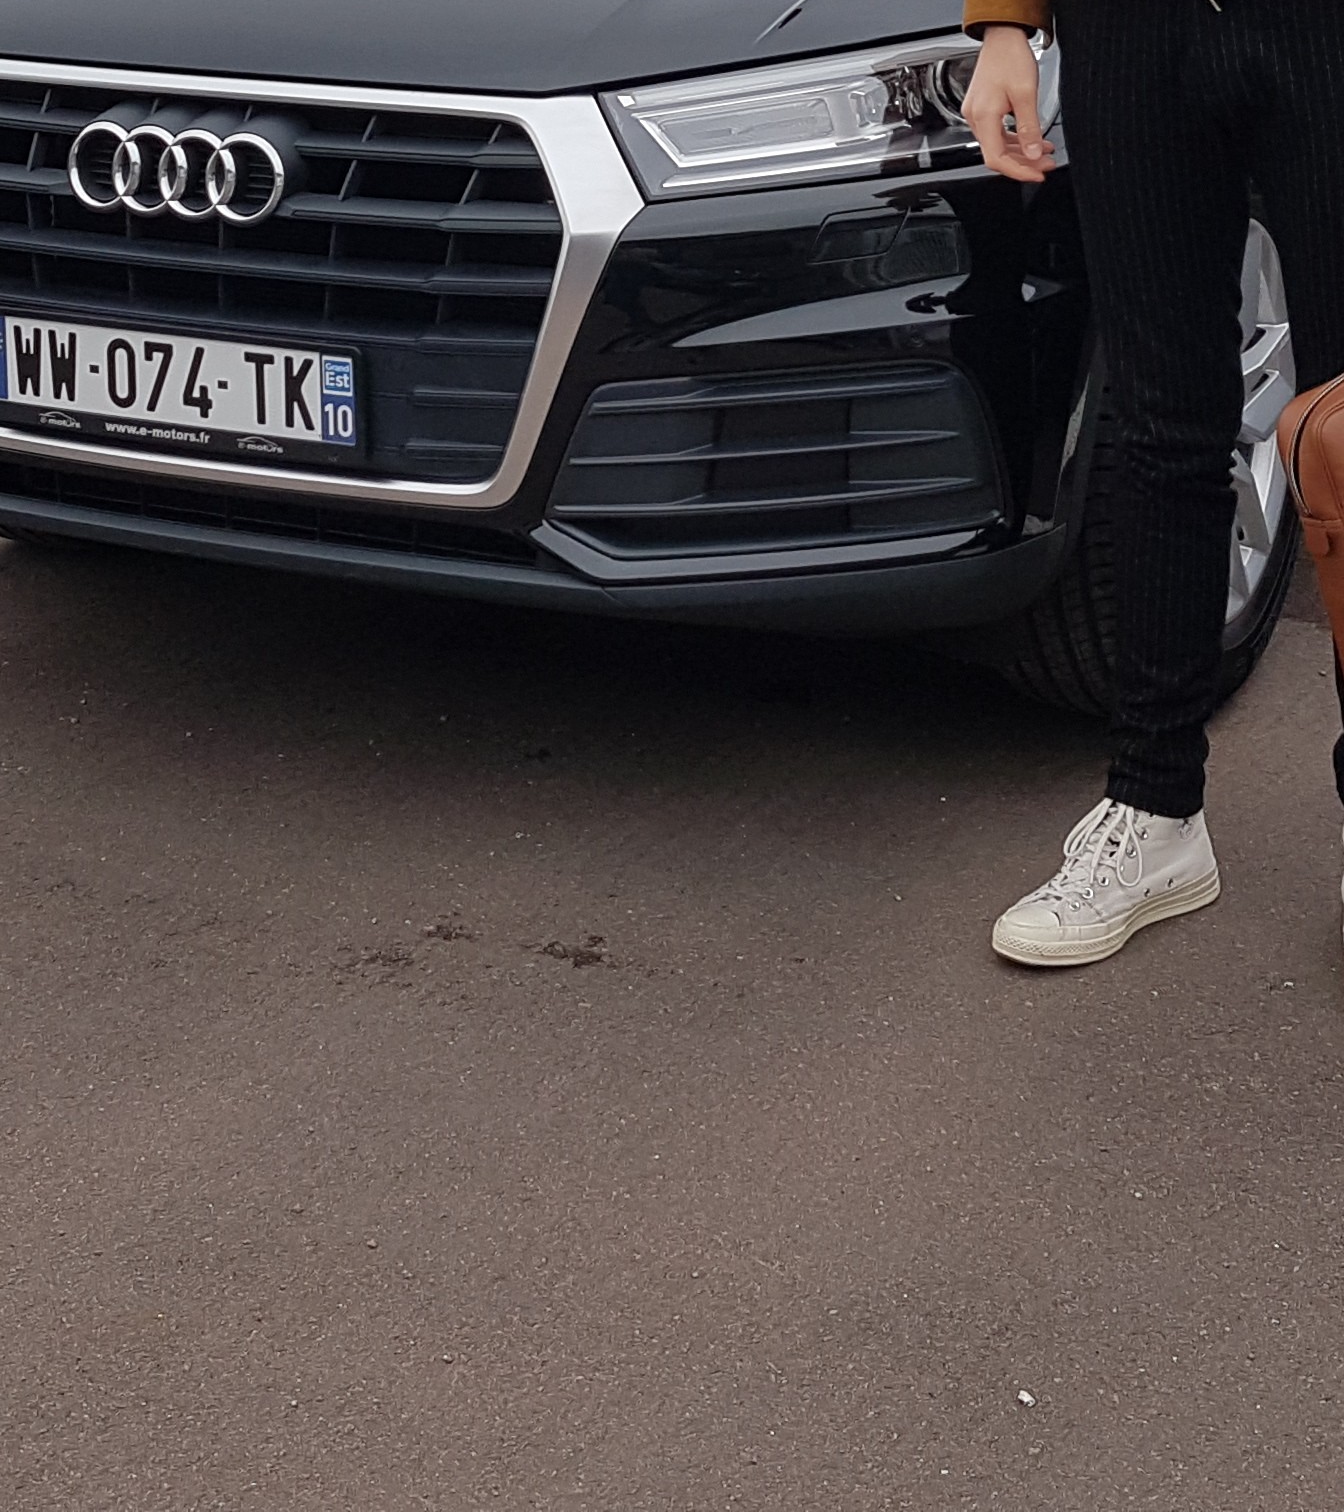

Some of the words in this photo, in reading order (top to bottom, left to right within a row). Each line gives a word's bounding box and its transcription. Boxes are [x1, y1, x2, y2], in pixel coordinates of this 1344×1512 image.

[13, 324, 316, 432] WW-074-TK
[325, 371, 350, 388] Est
[104, 422, 211, 444] www.e-motors.fr
[324, 402, 353, 438] 10
